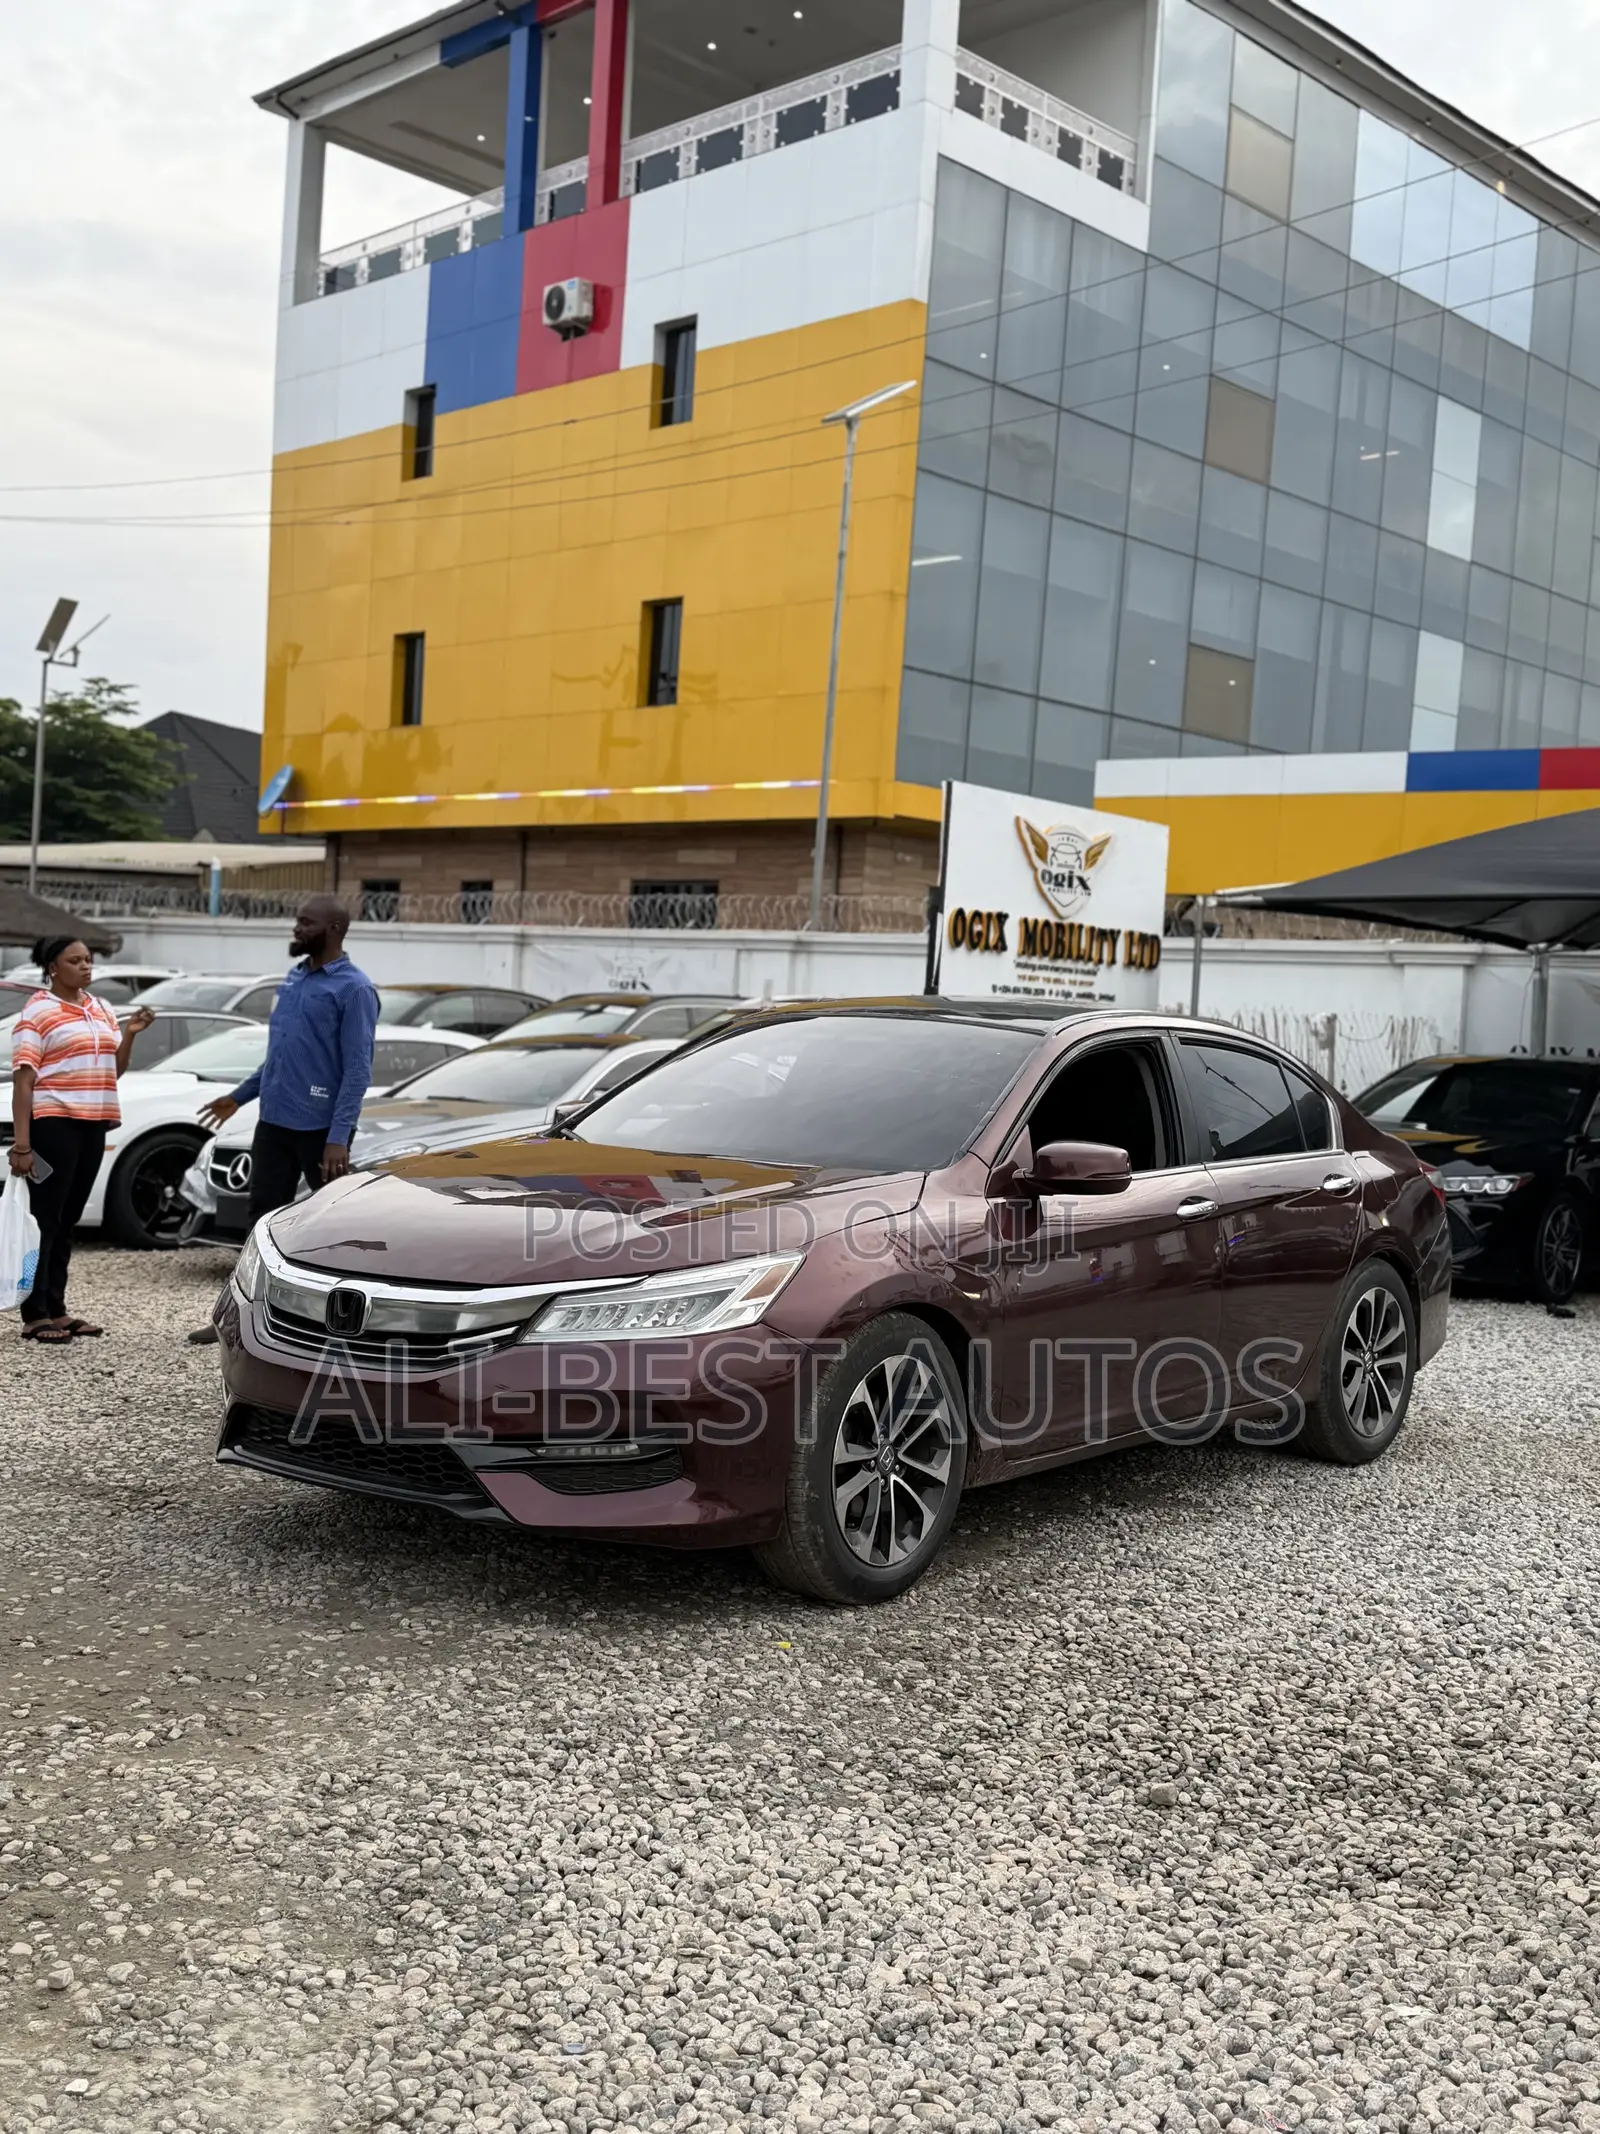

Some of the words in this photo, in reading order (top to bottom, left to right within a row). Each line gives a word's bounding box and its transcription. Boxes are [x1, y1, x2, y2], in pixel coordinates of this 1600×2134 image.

[948, 907, 1009, 952] OGIX
[1017, 917, 1121, 966] MOBILITY
[1123, 929, 1162, 971] LTD
